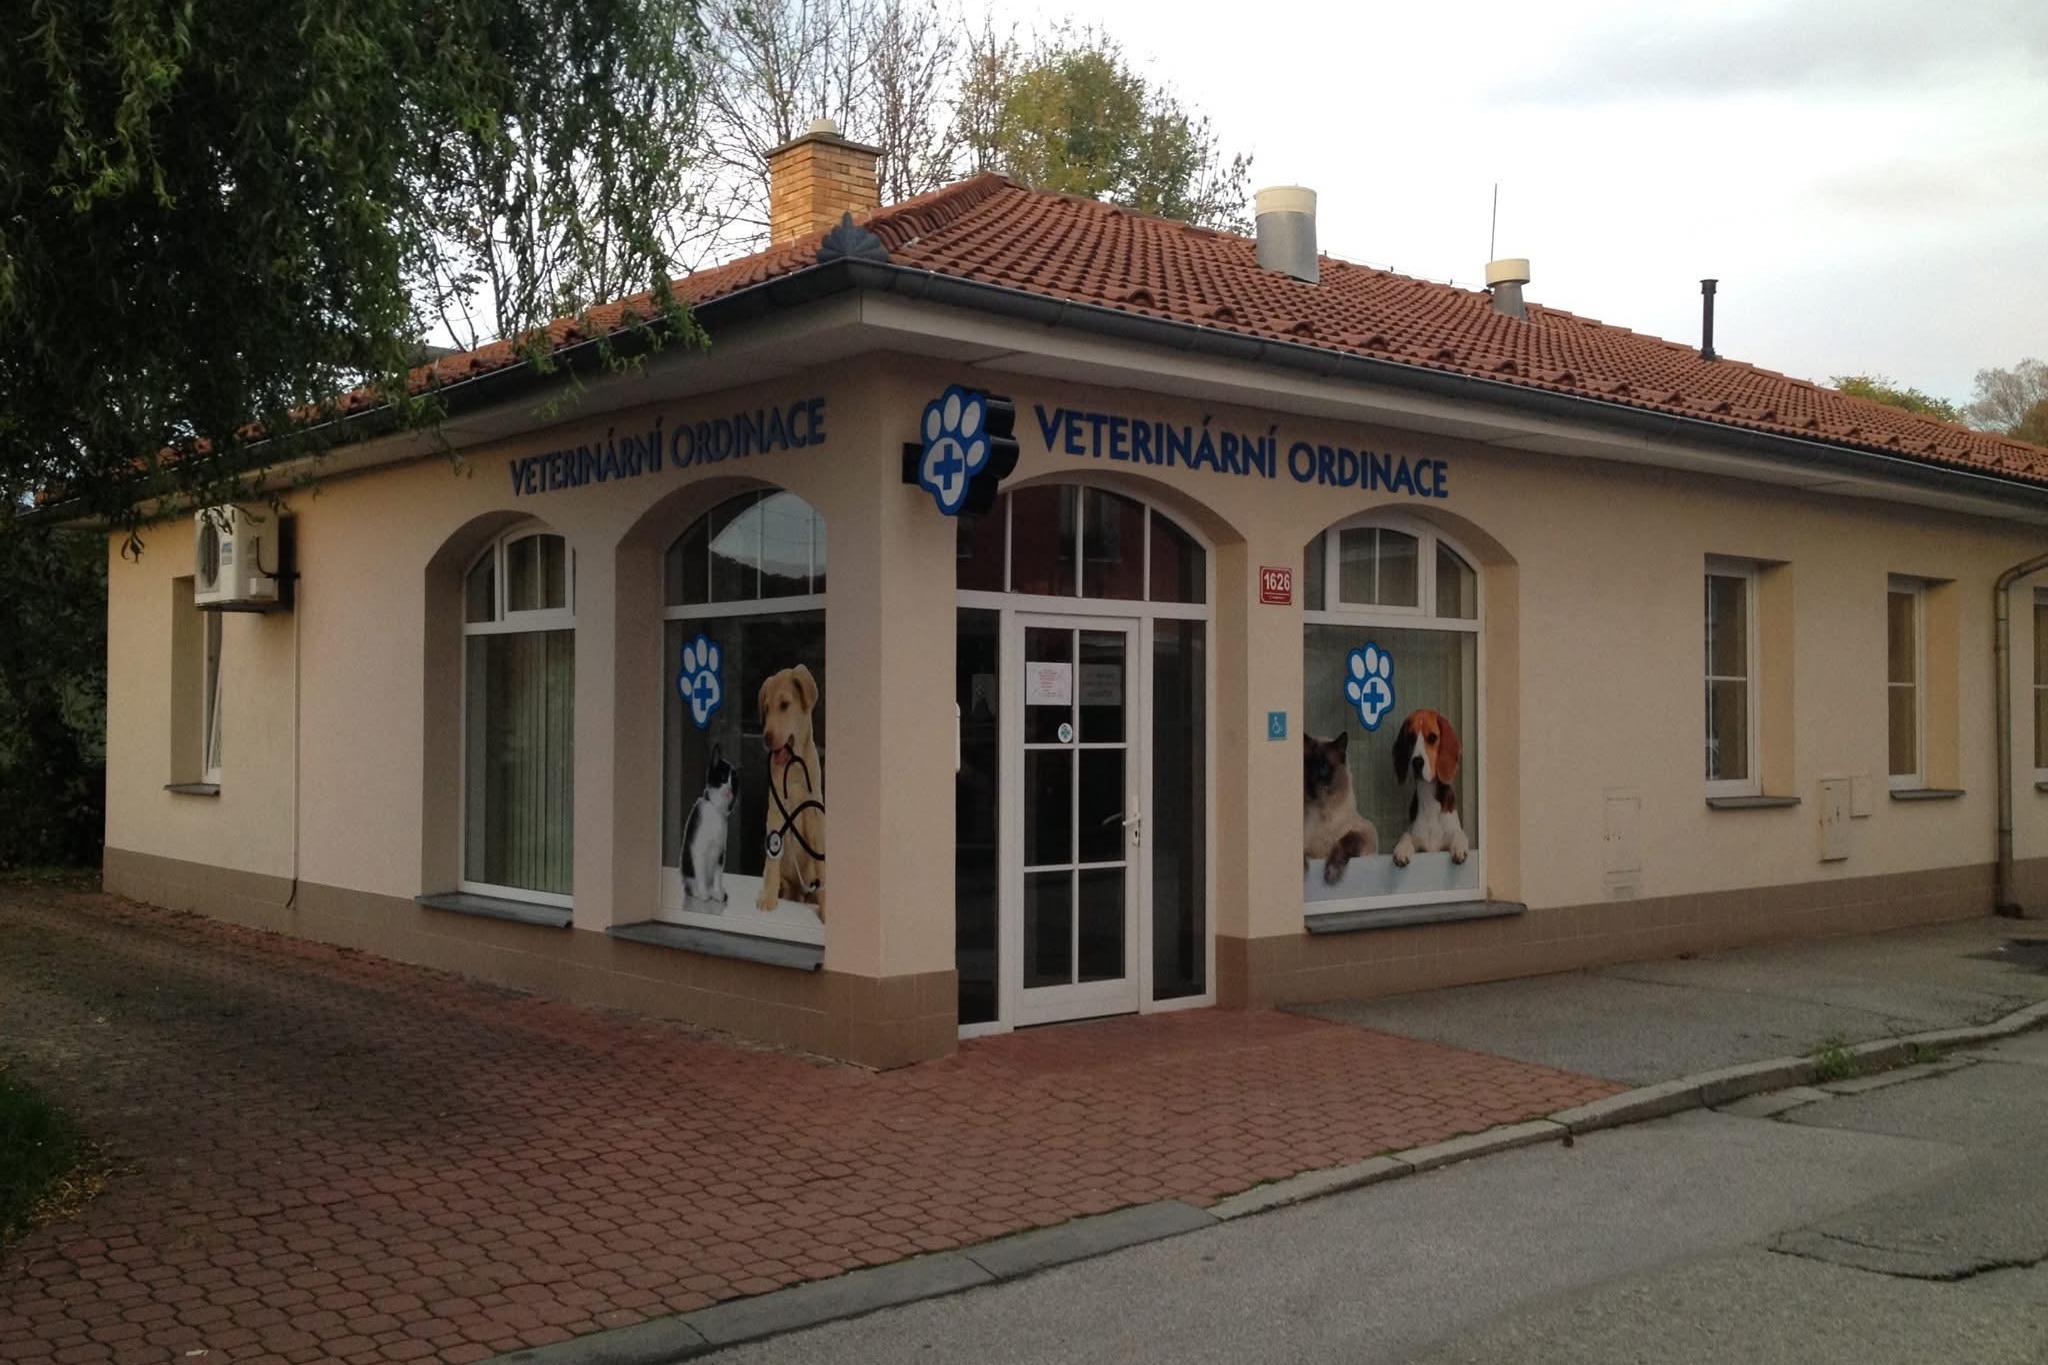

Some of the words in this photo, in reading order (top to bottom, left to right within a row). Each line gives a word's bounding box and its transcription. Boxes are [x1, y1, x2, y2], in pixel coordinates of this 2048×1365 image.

[510, 415, 663, 497] VETERINÁRNÍ
[671, 397, 827, 470] ORDINACE
[1034, 404, 1279, 479] VETERINÁRNÍ
[1288, 441, 1449, 498] ORDINACE
[1264, 572, 1291, 592] 1626
